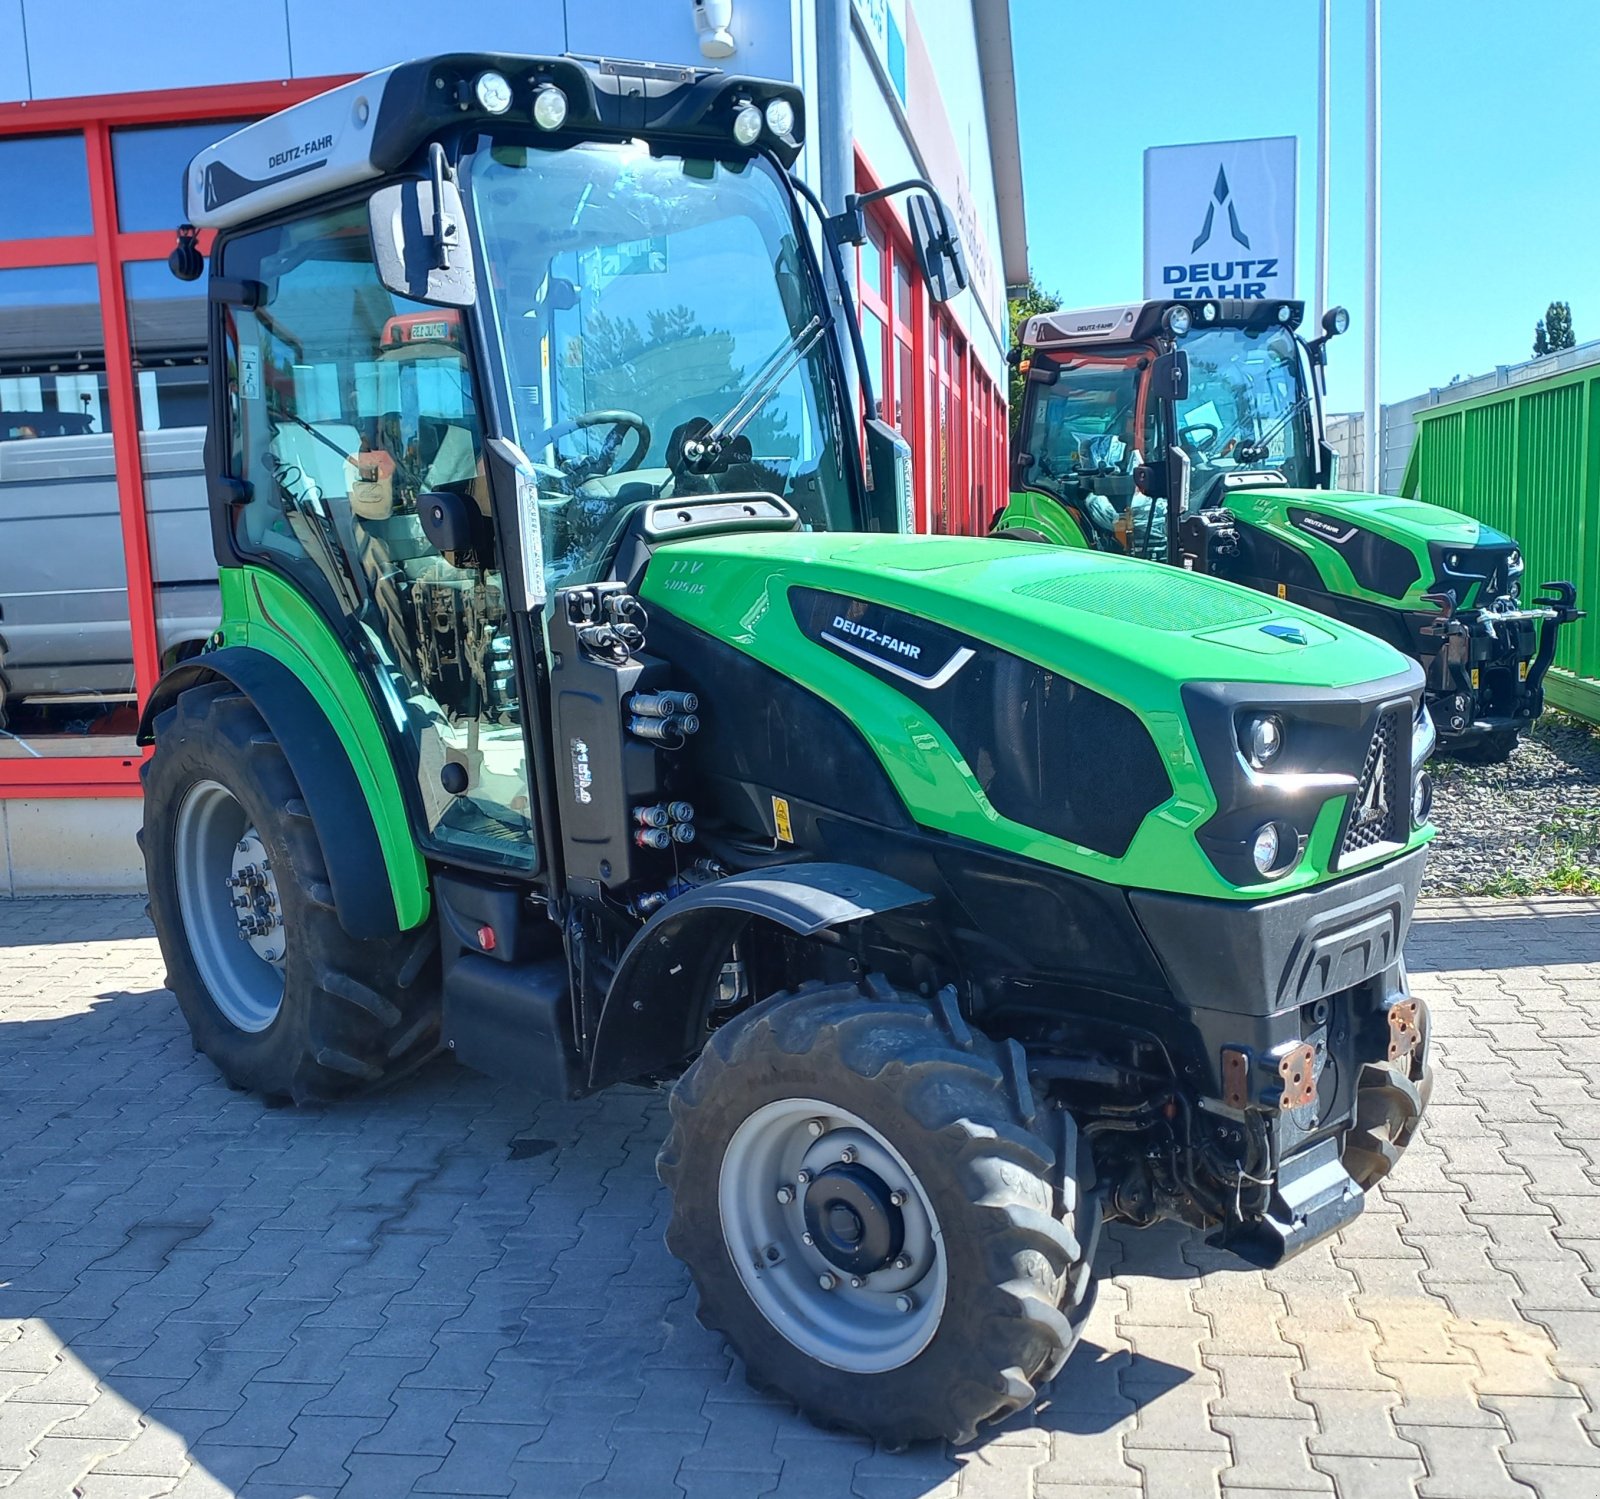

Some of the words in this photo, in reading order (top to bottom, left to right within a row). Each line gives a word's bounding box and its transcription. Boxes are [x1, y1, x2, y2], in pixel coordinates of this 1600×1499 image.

[268, 134, 333, 169] DEUTZ-FAHR
[1163, 258, 1278, 285] DEUTZ
[1173, 282, 1266, 299] FAHR
[1077, 322, 1114, 332] DEUTZ-FAHR
[1303, 517, 1340, 533] DEUTZ-FAHR
[832, 615, 921, 659] DEUTZ-FAHR
